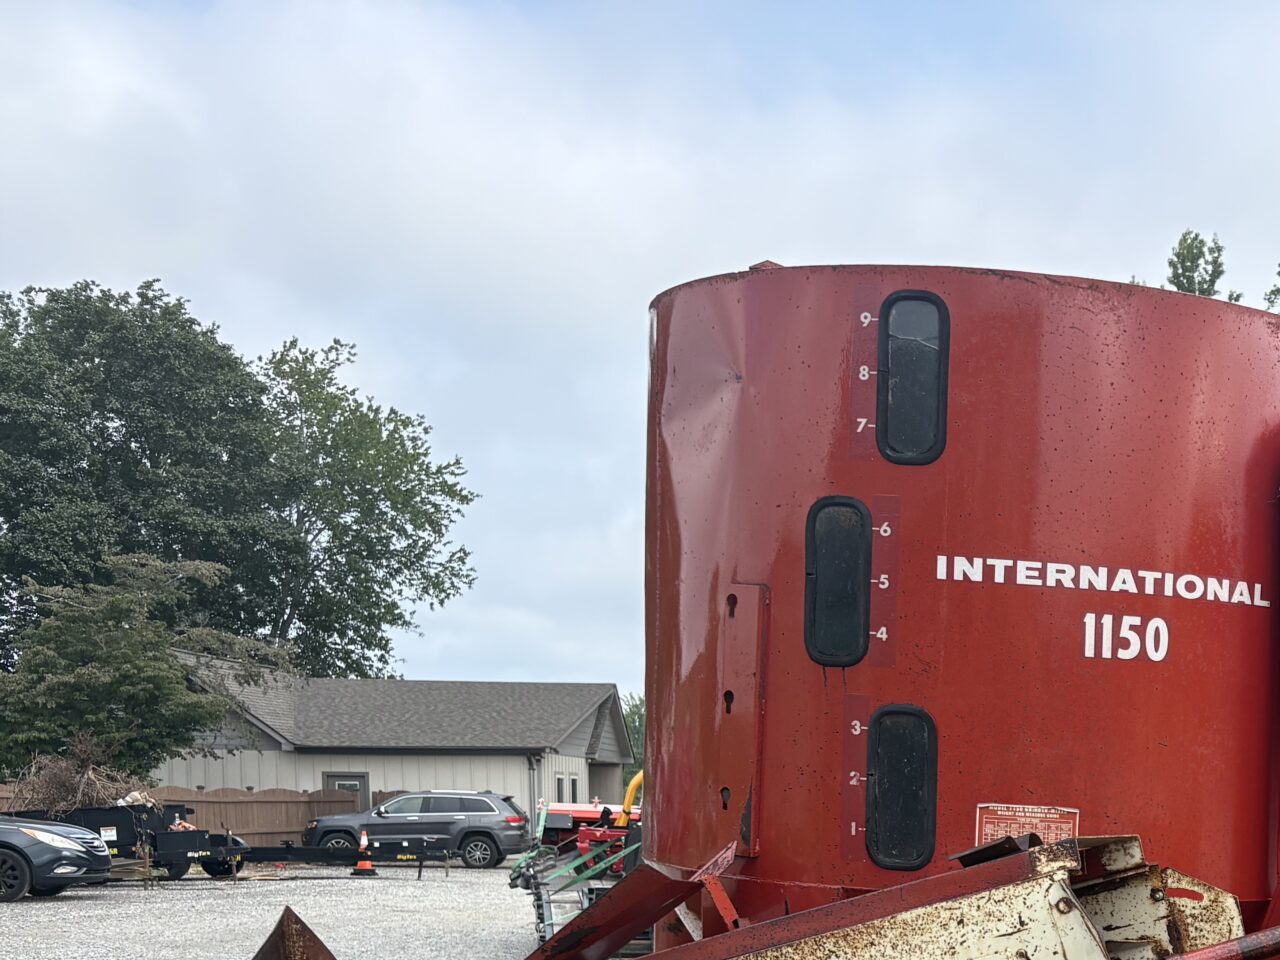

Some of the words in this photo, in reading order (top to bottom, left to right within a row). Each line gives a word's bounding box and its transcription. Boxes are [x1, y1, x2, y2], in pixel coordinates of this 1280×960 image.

[860, 312, 871, 327] 9
[859, 365, 869, 380] 8
[856, 418, 867, 433] 7
[880, 522, 891, 537] 6
[879, 574, 889, 589] 5
[936, 555, 1271, 608] INTERNATIONAL
[876, 627, 888, 641] 4
[1083, 612, 1169, 662] 1150
[851, 720, 861, 735] 3
[849, 771, 860, 785] 2
[851, 822, 856, 835] 1
